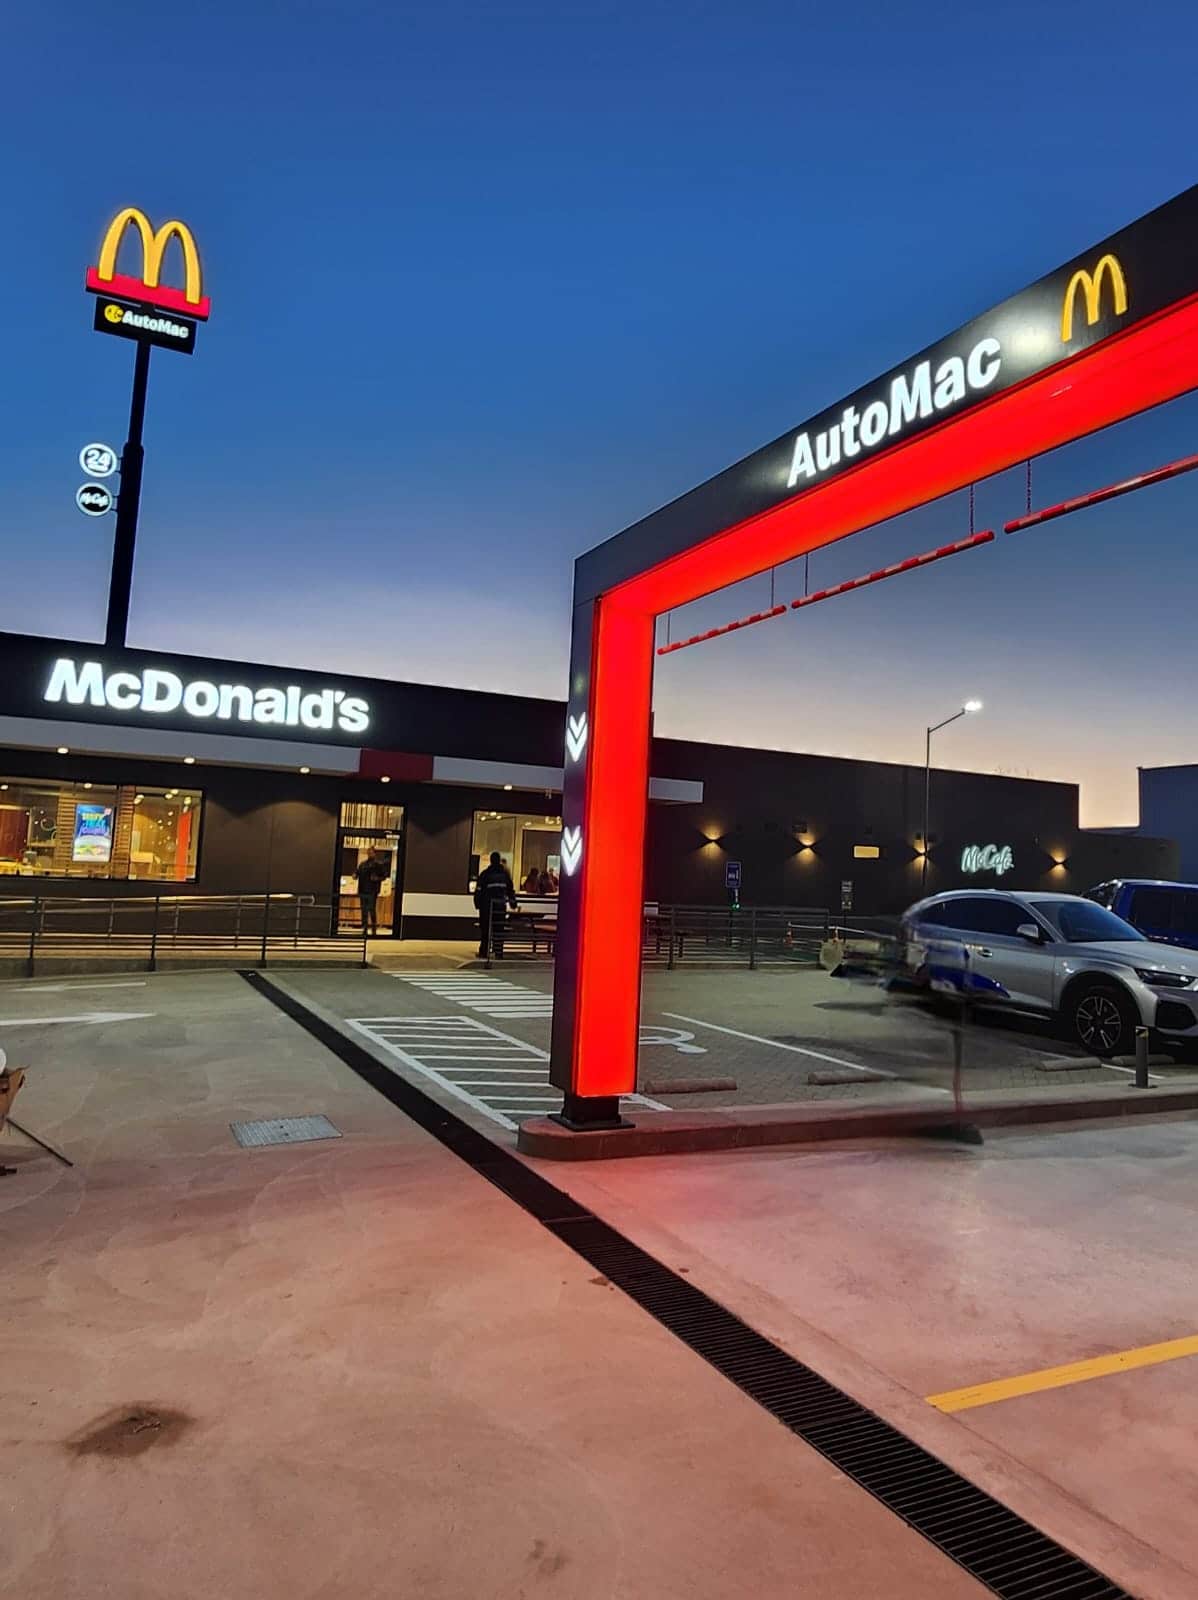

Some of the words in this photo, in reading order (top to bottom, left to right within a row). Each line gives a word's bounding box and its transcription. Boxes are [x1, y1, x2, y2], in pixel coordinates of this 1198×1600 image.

[122, 310, 190, 339] AutoMac
[786, 337, 1003, 488] AutoMac
[86, 448, 111, 468] 24
[43, 657, 371, 733] McDonald's
